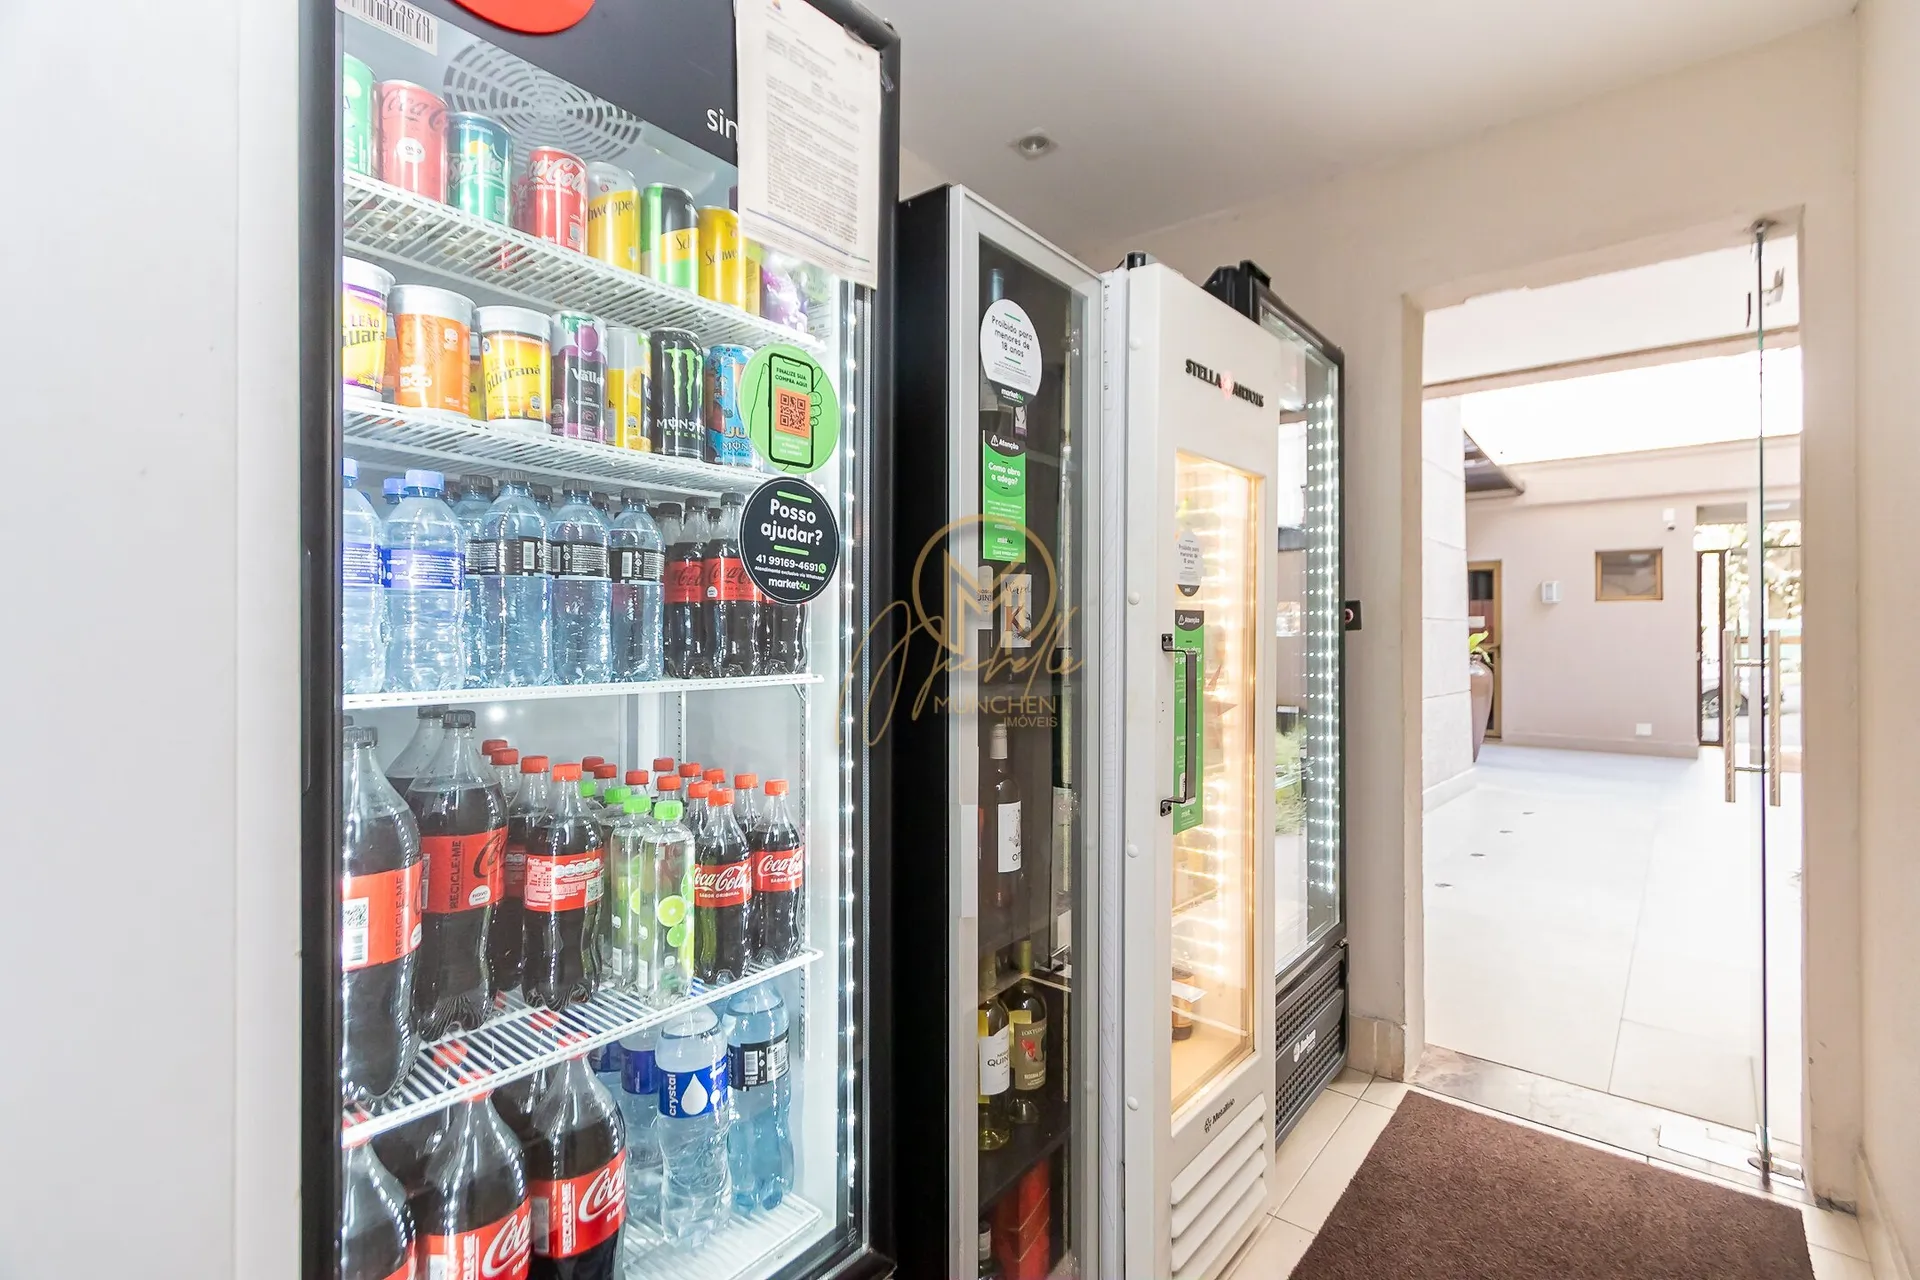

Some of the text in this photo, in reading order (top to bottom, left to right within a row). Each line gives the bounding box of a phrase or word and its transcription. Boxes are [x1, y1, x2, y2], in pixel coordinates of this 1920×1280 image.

[1185, 358, 1222, 389] STELLA
[770, 498, 816, 524] Posso
[760, 520, 823, 546] ajudar?
[756, 554, 818, 572] 41 99169-4691
[768, 578, 810, 591] market4u
[668, 1074, 678, 1116] crystal
